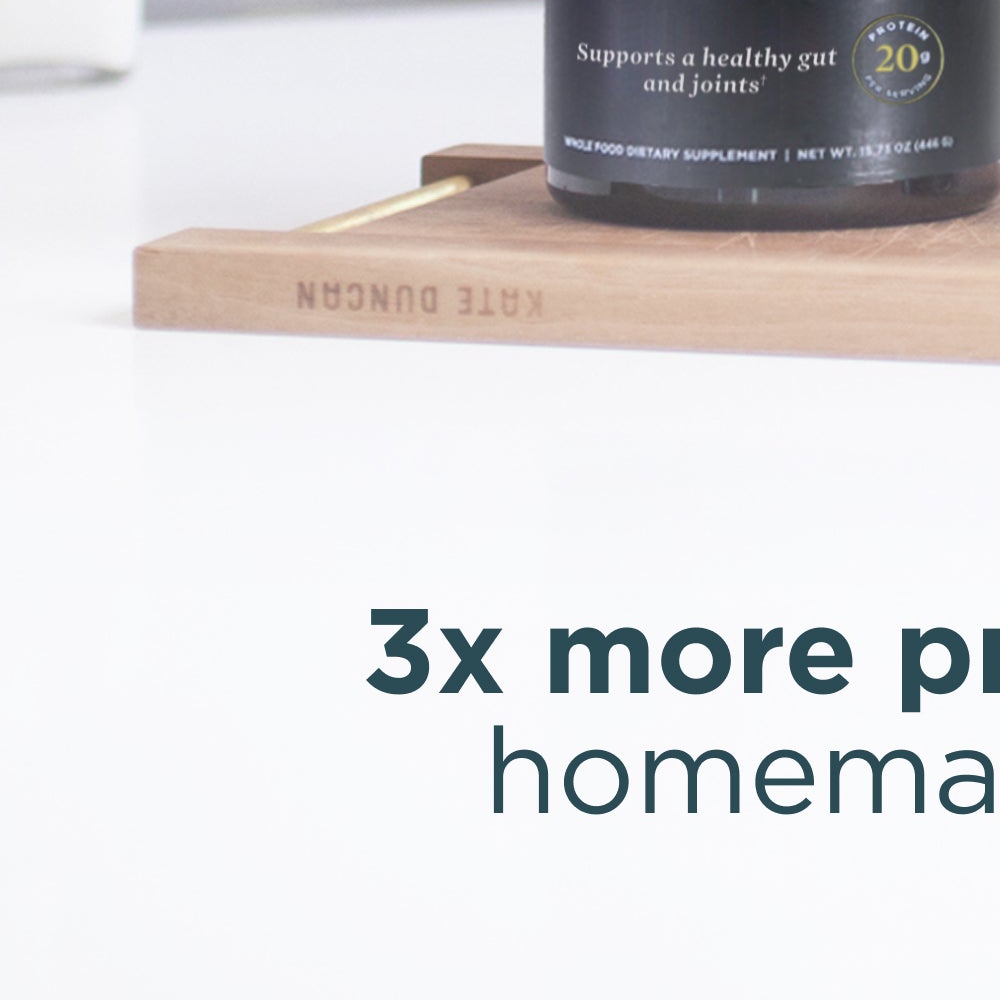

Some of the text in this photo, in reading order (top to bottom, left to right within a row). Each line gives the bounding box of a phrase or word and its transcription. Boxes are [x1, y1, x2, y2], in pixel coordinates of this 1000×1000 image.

[868, 20, 930, 42] PROTEIN
[576, 42, 838, 72] Supports a healthy gut
[643, 73, 685, 94] and
[594, 140, 625, 157] FOOD
[626, 144, 680, 161] DIETARY
[683, 147, 777, 162] SUPPLEMENT
[797, 148, 826, 161] NET
[829, 146, 858, 160] WT.
[893, 141, 913, 155] OZ
[296, 281, 544, 318] KATE DUNCAN
